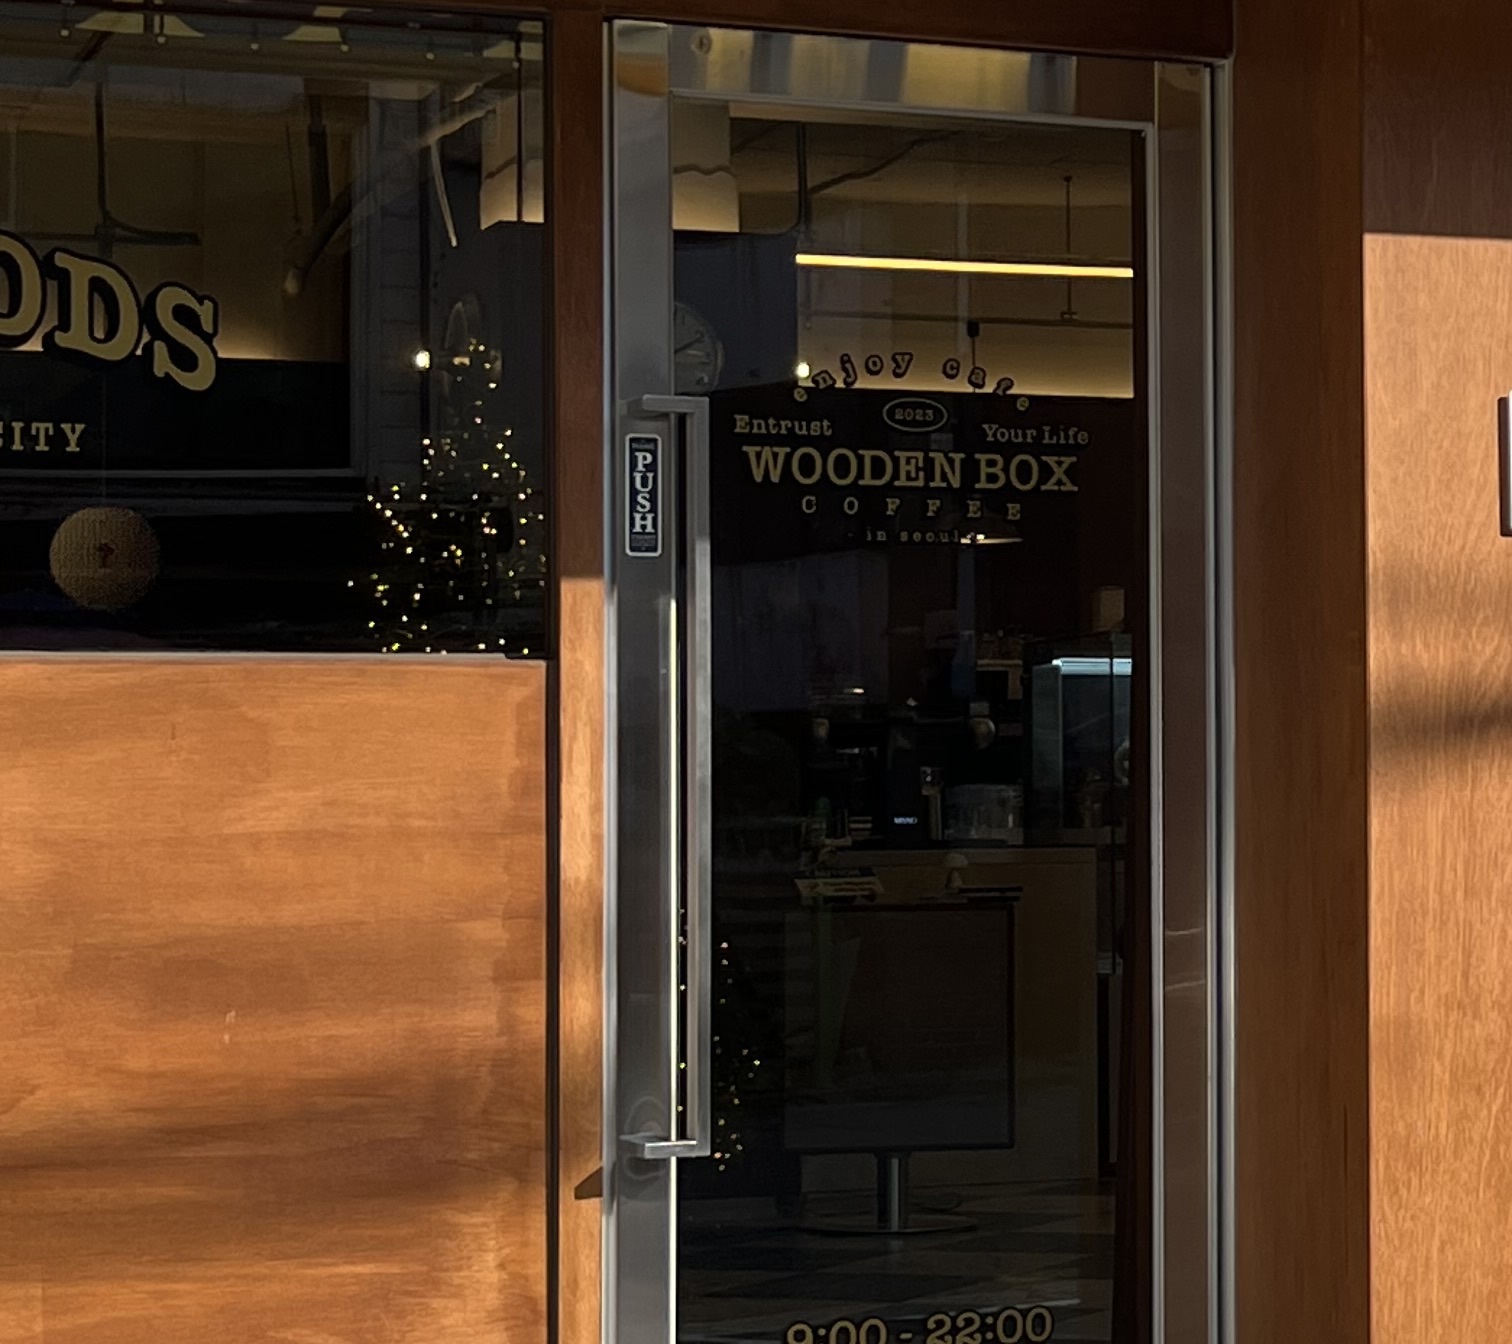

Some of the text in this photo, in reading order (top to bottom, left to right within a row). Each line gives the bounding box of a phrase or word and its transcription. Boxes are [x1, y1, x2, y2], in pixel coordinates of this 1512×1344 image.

[792, 351, 1032, 413] enjoy cafe
[732, 413, 1091, 447] Entrust Your Life
[893, 407, 935, 422] 2023
[0, 420, 86, 453] ITY
[741, 444, 1080, 493] WOODEN BOX
[632, 450, 656, 534] PUSH
[800, 495, 1023, 522] COFFEE
